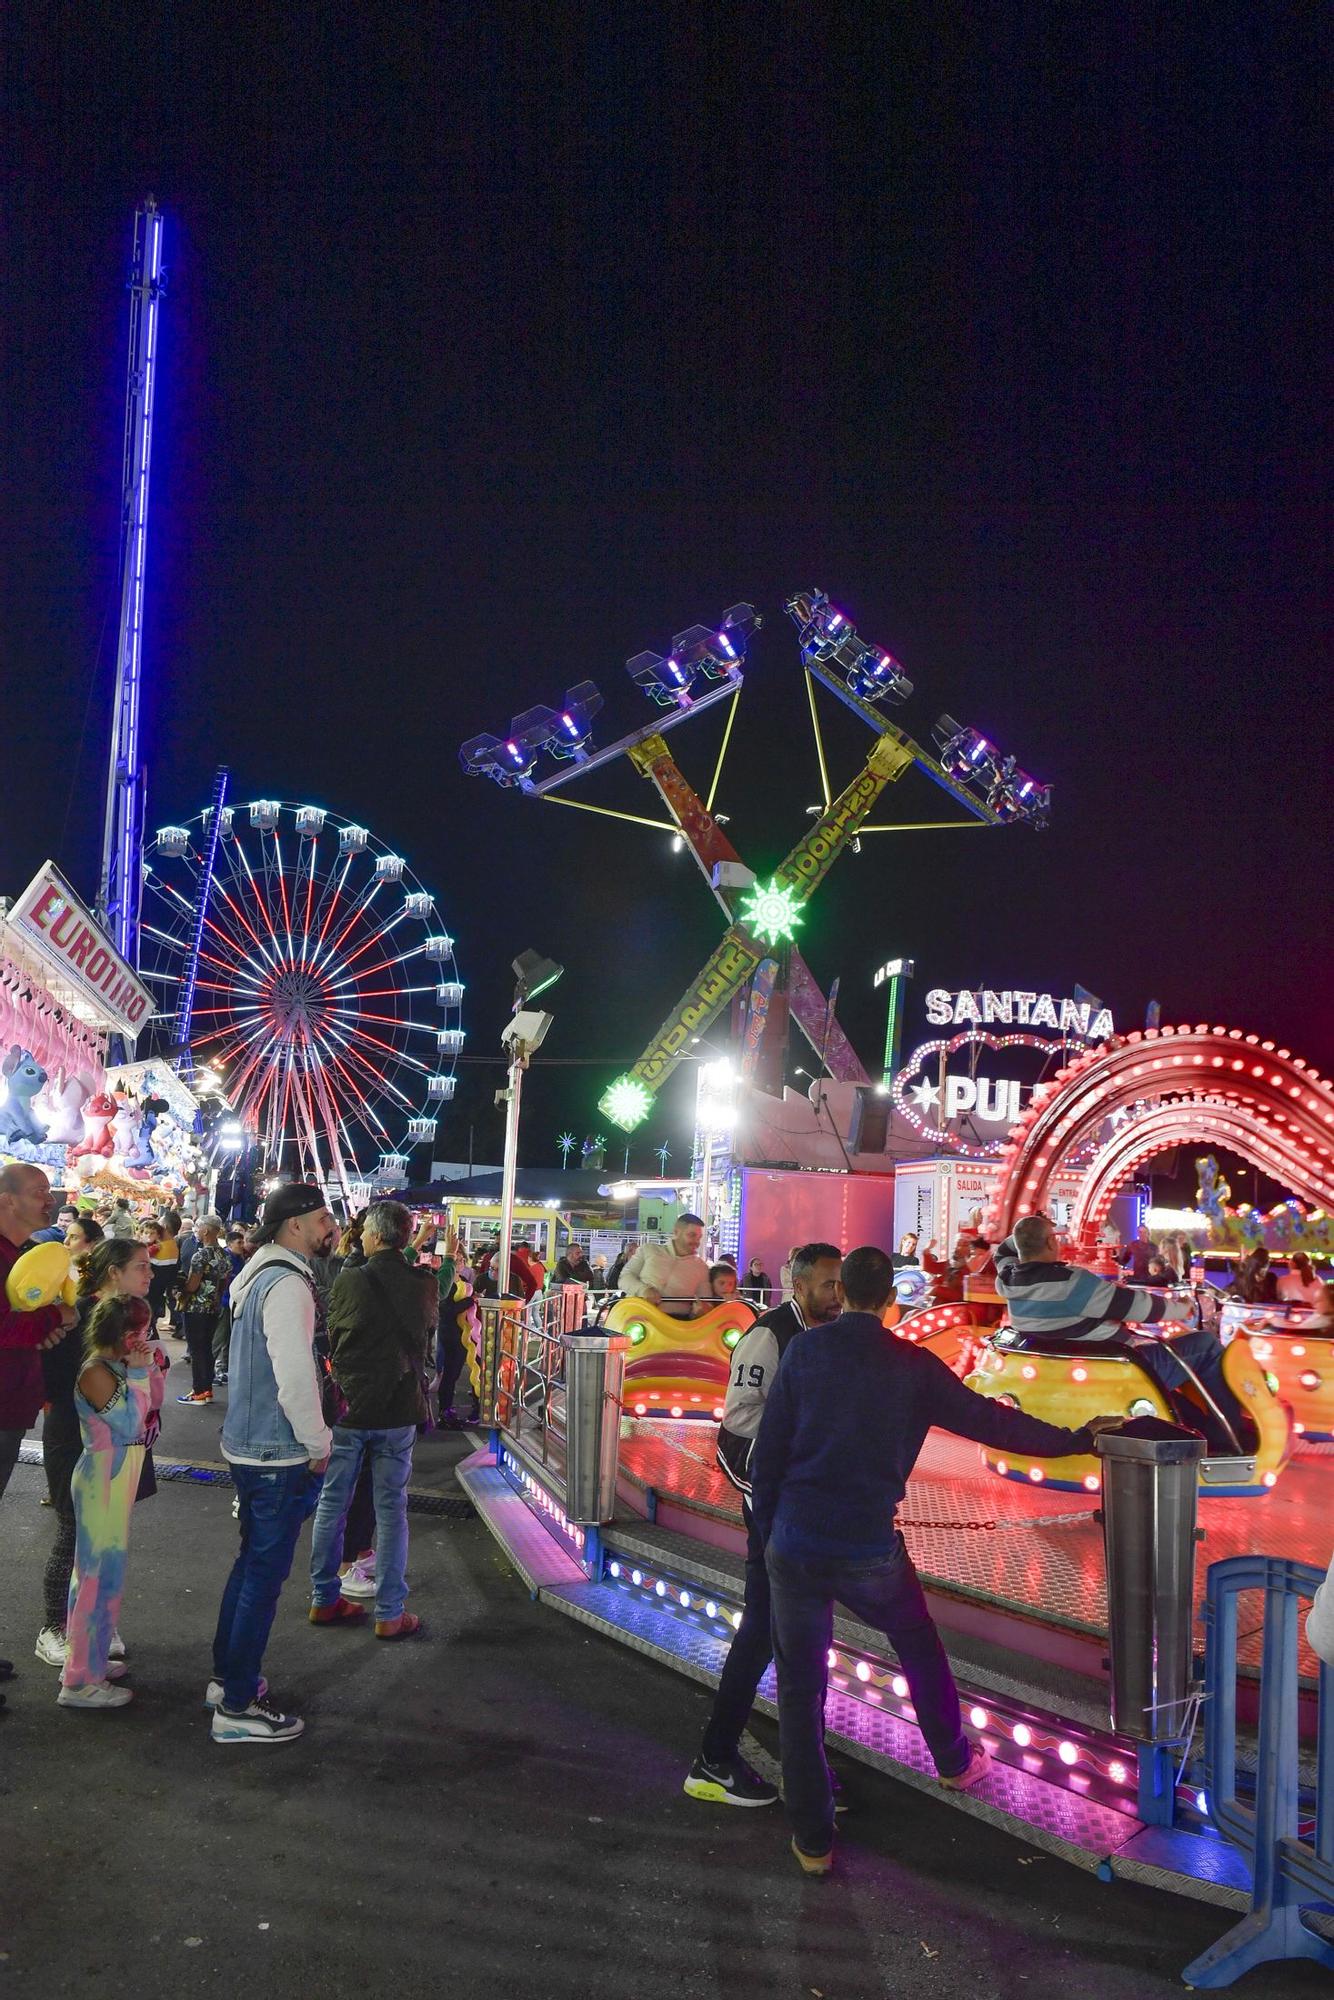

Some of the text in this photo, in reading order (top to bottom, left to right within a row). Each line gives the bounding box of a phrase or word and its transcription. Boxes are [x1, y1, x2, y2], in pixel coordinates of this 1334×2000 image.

[29, 884, 147, 1023] EUROTIRO
[641, 941, 754, 1081] SUPER
[781, 775, 878, 899] LOOPING
[925, 988, 1114, 1040] SANTANA
[956, 1180, 983, 1191] SALIDA
[734, 1364, 765, 1387] 19
